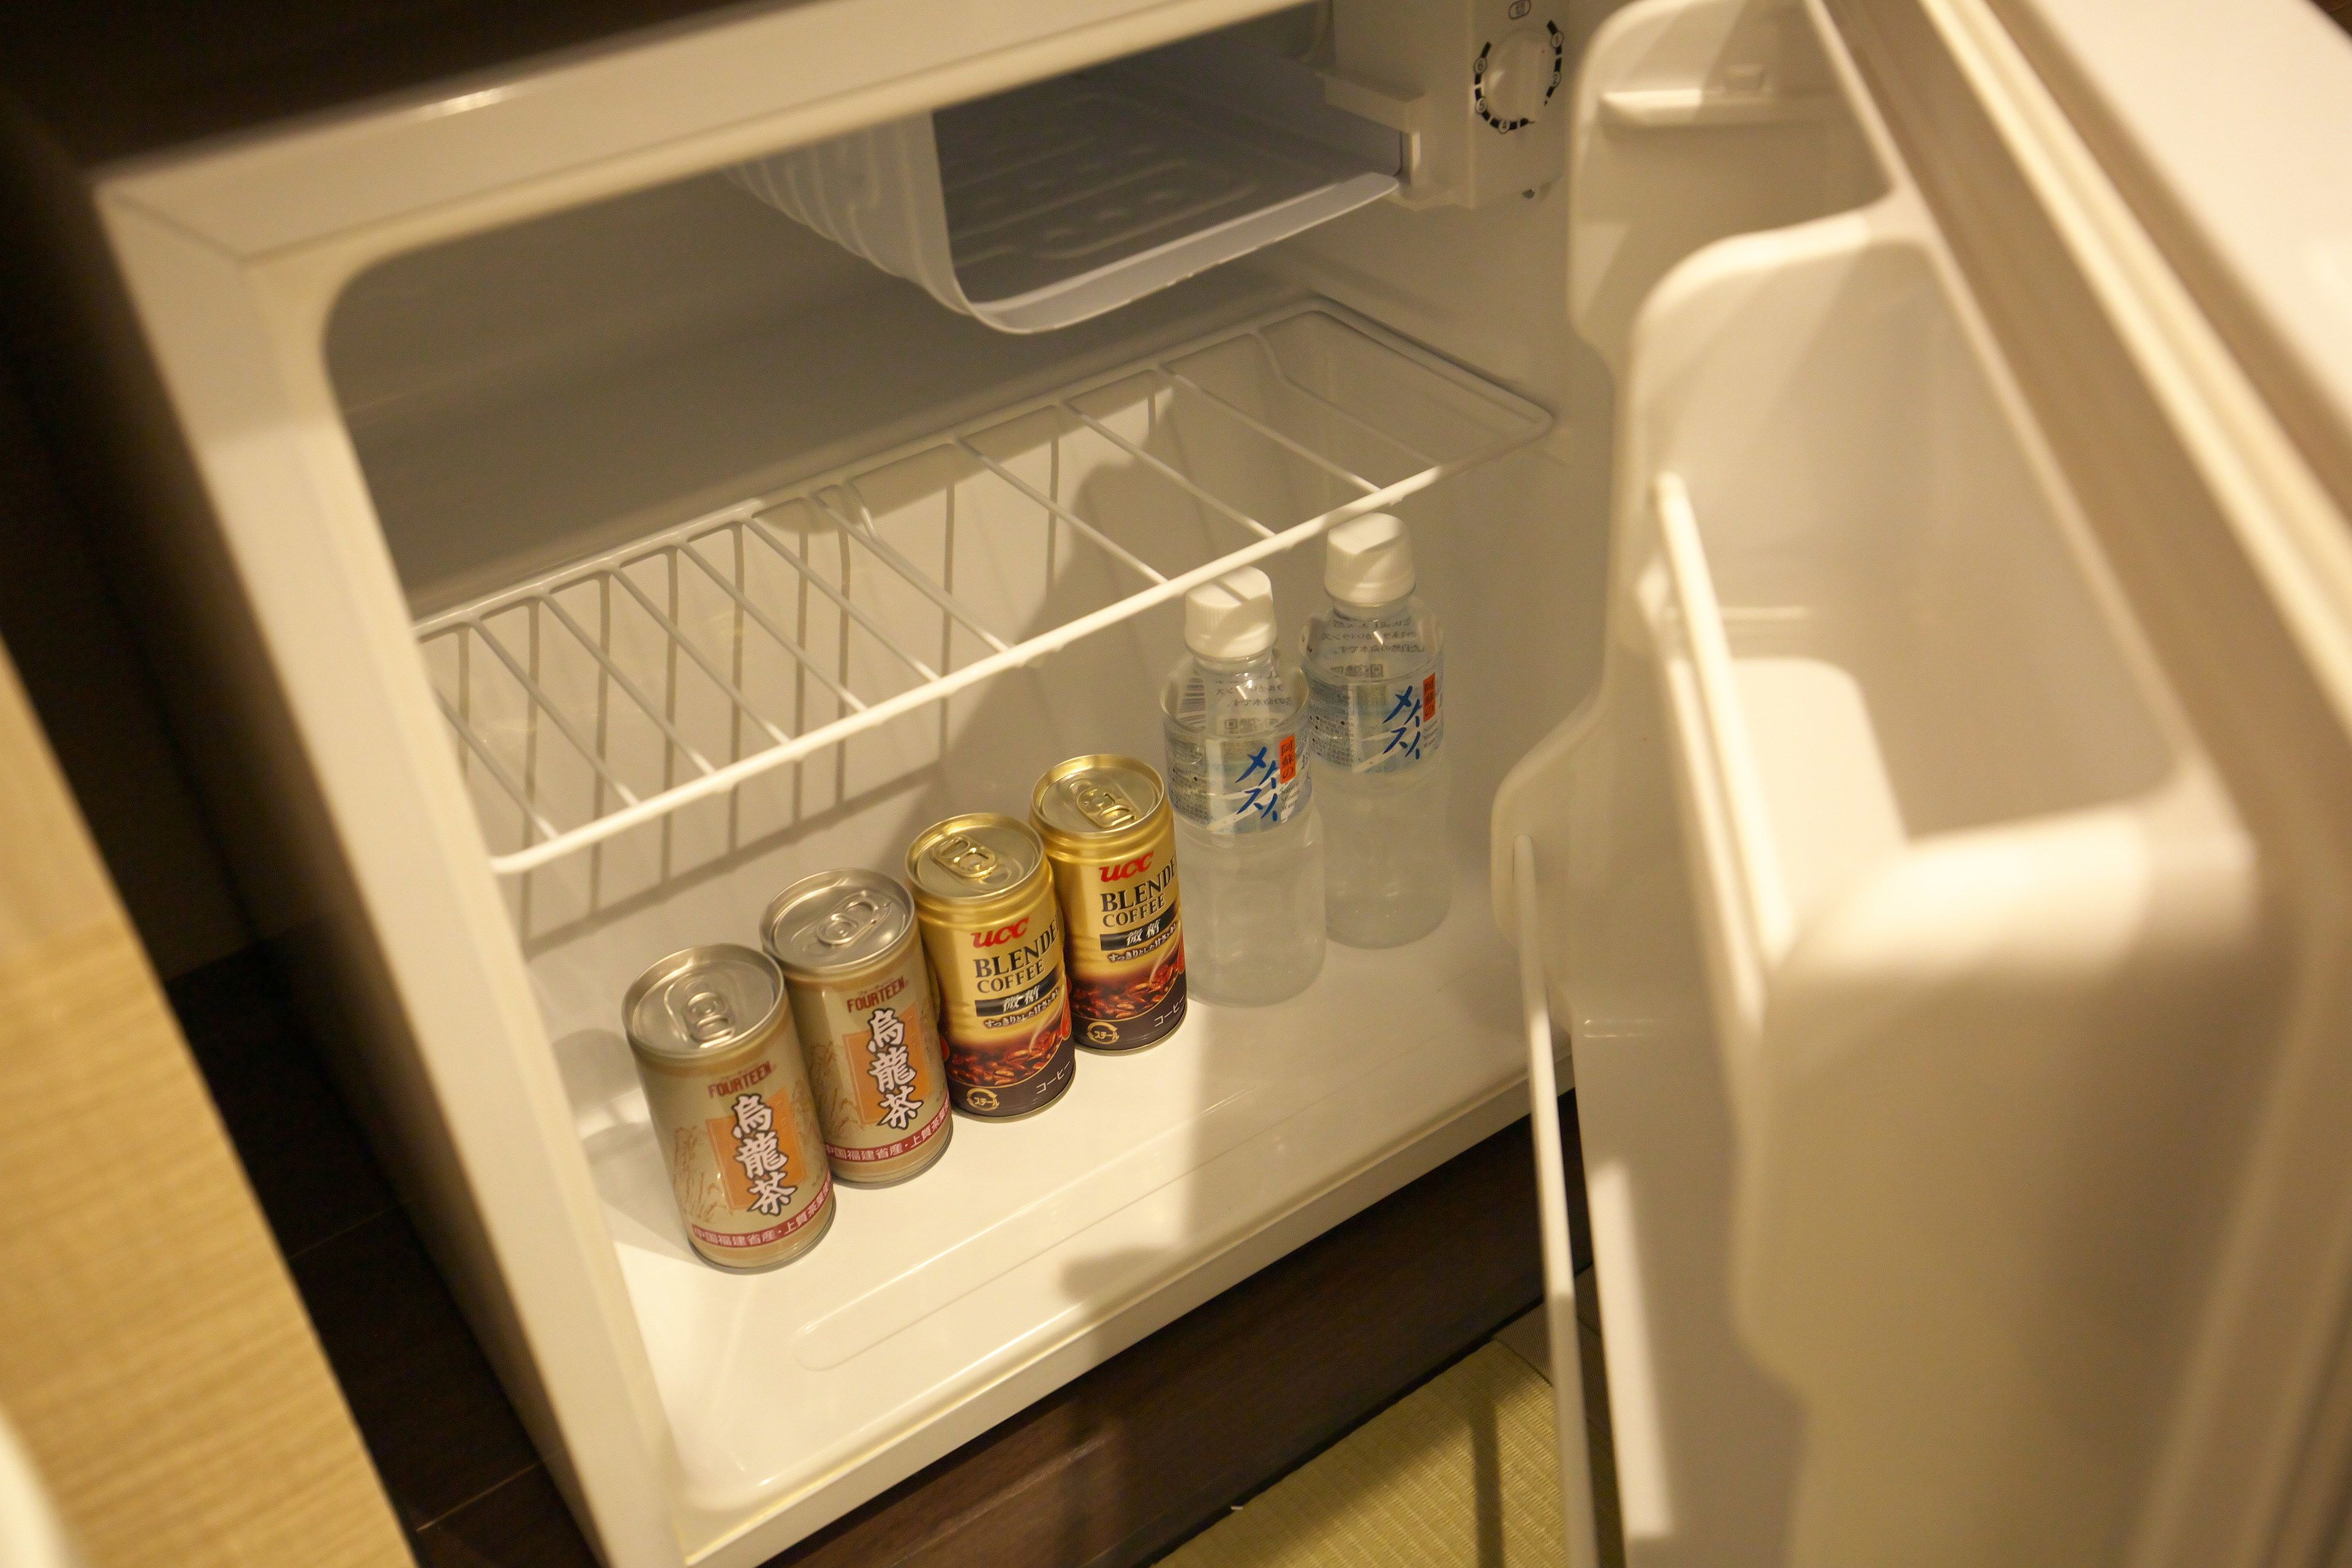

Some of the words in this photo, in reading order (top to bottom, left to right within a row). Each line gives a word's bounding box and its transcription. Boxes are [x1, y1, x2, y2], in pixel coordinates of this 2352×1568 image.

[1102, 892, 1166, 927] COFFEE
[977, 959, 1044, 993] COFFEE
[847, 976, 905, 1012] FOURTEEN
[1155, 995, 1185, 1027] コーヒー
[1094, 1030, 1120, 1039] スチール
[707, 1060, 772, 1098] FOURTEEN
[867, 1008, 924, 1130] 烏龍茶
[1036, 1061, 1070, 1094] コーヒー
[974, 1097, 1000, 1106] スチール
[732, 1093, 797, 1216] 烏龍茶
